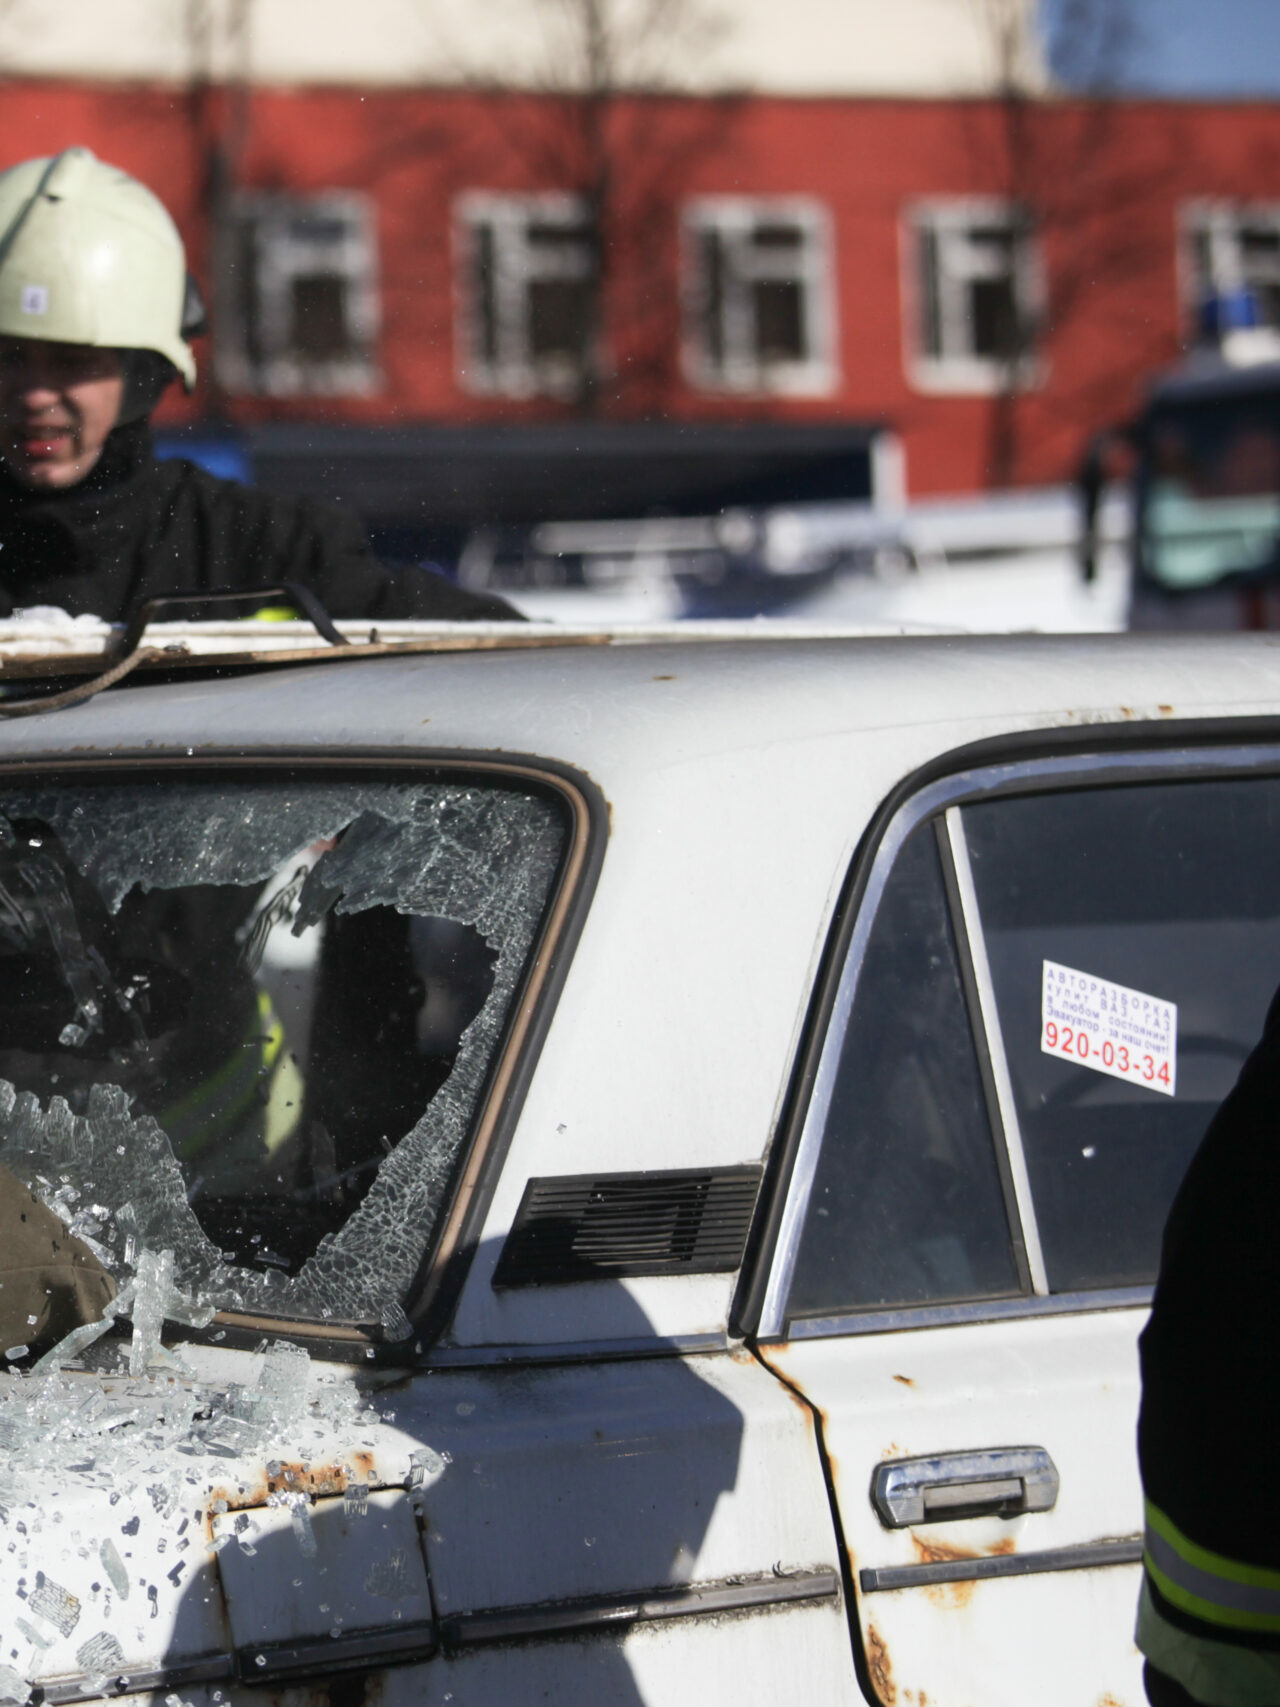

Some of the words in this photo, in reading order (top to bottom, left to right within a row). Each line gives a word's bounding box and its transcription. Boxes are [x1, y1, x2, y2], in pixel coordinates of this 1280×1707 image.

[1046, 995, 1054, 1005] в
[1062, 1000, 1100, 1020] любом
[1047, 969, 1170, 1020] АВТОРАЗБОРКА
[1047, 983, 1089, 1006] купит
[1144, 1013, 1171, 1033] ГАЗ
[1047, 1004, 1100, 1033] Эвакуатор
[1109, 1028, 1119, 1039] за
[1121, 1034, 1142, 1047] наш
[1046, 1022, 1170, 1085] 920-03-34
